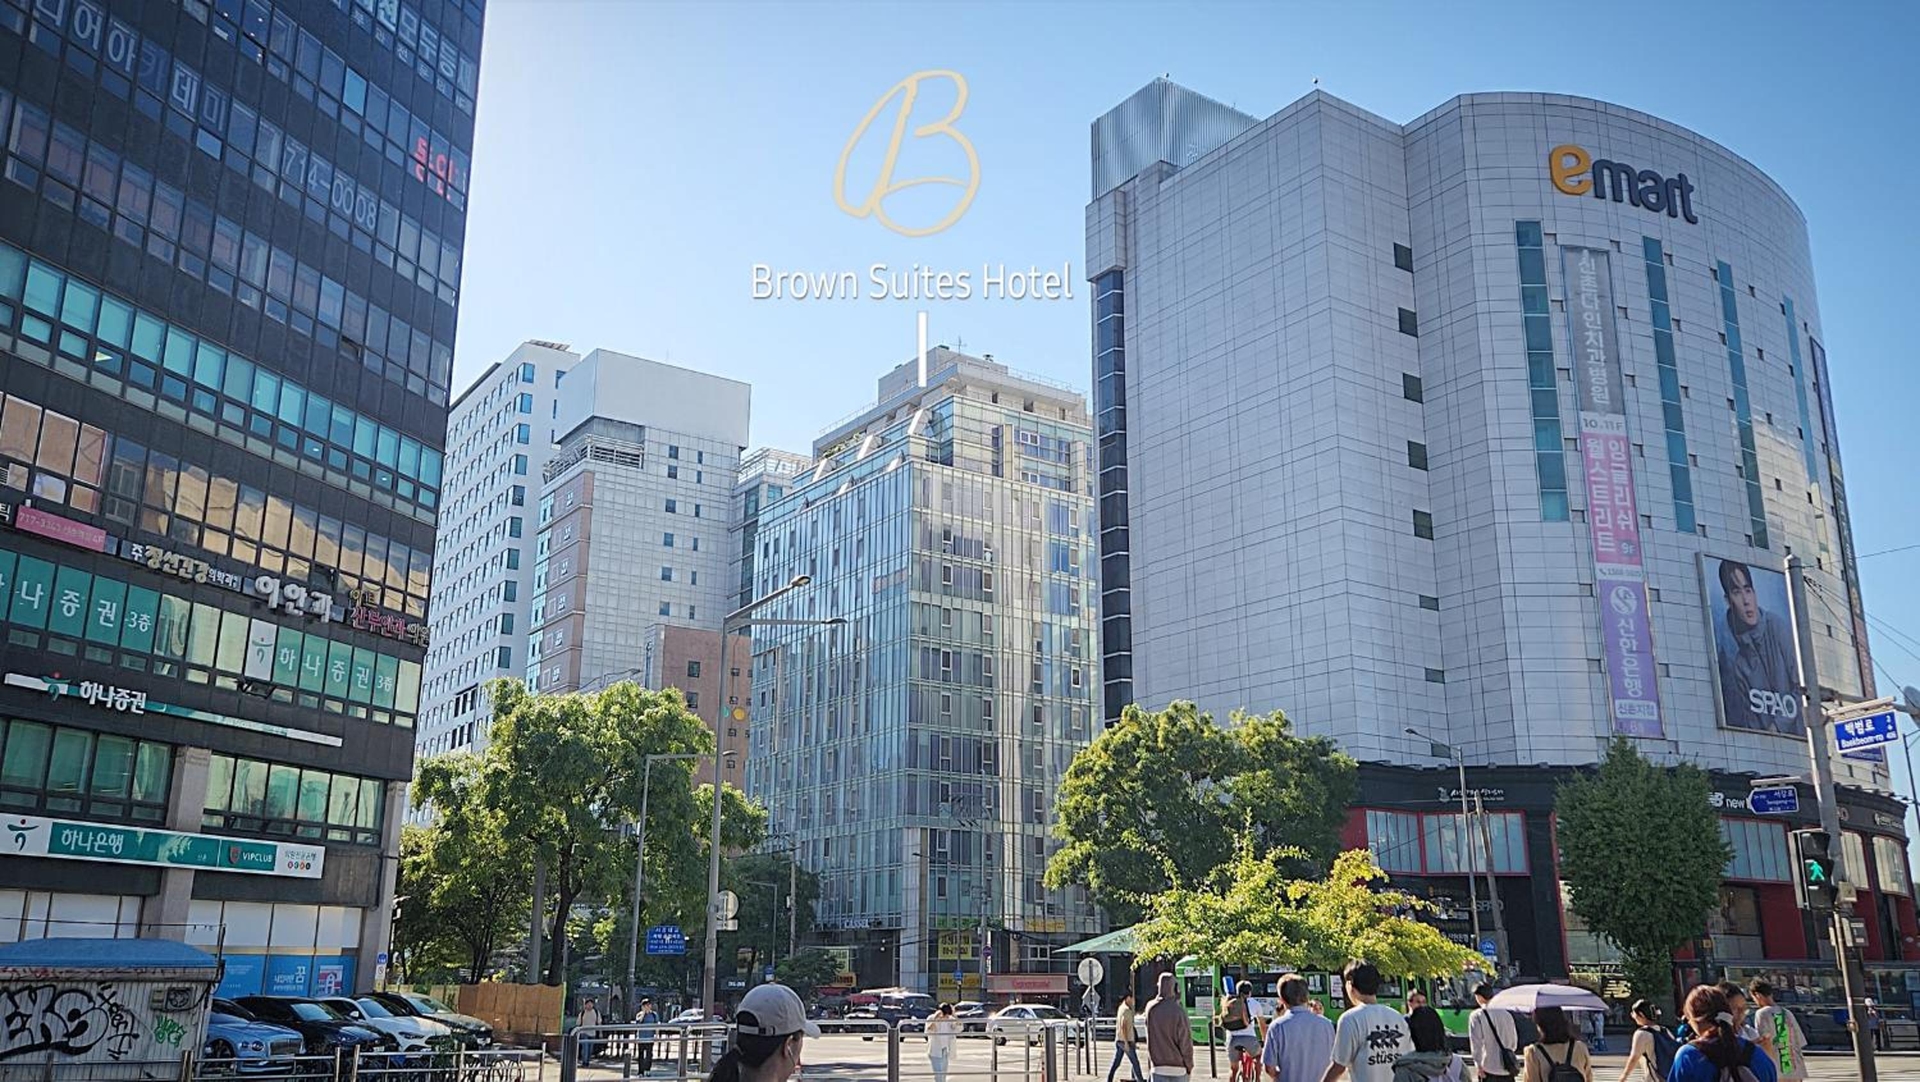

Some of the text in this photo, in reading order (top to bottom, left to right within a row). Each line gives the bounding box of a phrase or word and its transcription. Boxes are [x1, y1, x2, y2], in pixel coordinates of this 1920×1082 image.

[284, 146, 377, 231] 714-0008
[1549, 144, 1698, 225] emart
[1586, 437, 1617, 552] 월스트리트
[128, 611, 151, 632] 3층
[255, 575, 333, 624] 이안과
[278, 648, 393, 693] 하나증권 3층
[1617, 618, 1643, 698] 신한은행
[79, 680, 147, 714] 하나증권
[1749, 688, 1798, 718] SPAO
[1725, 798, 1746, 809] new
[61, 829, 124, 855] 하나은행
